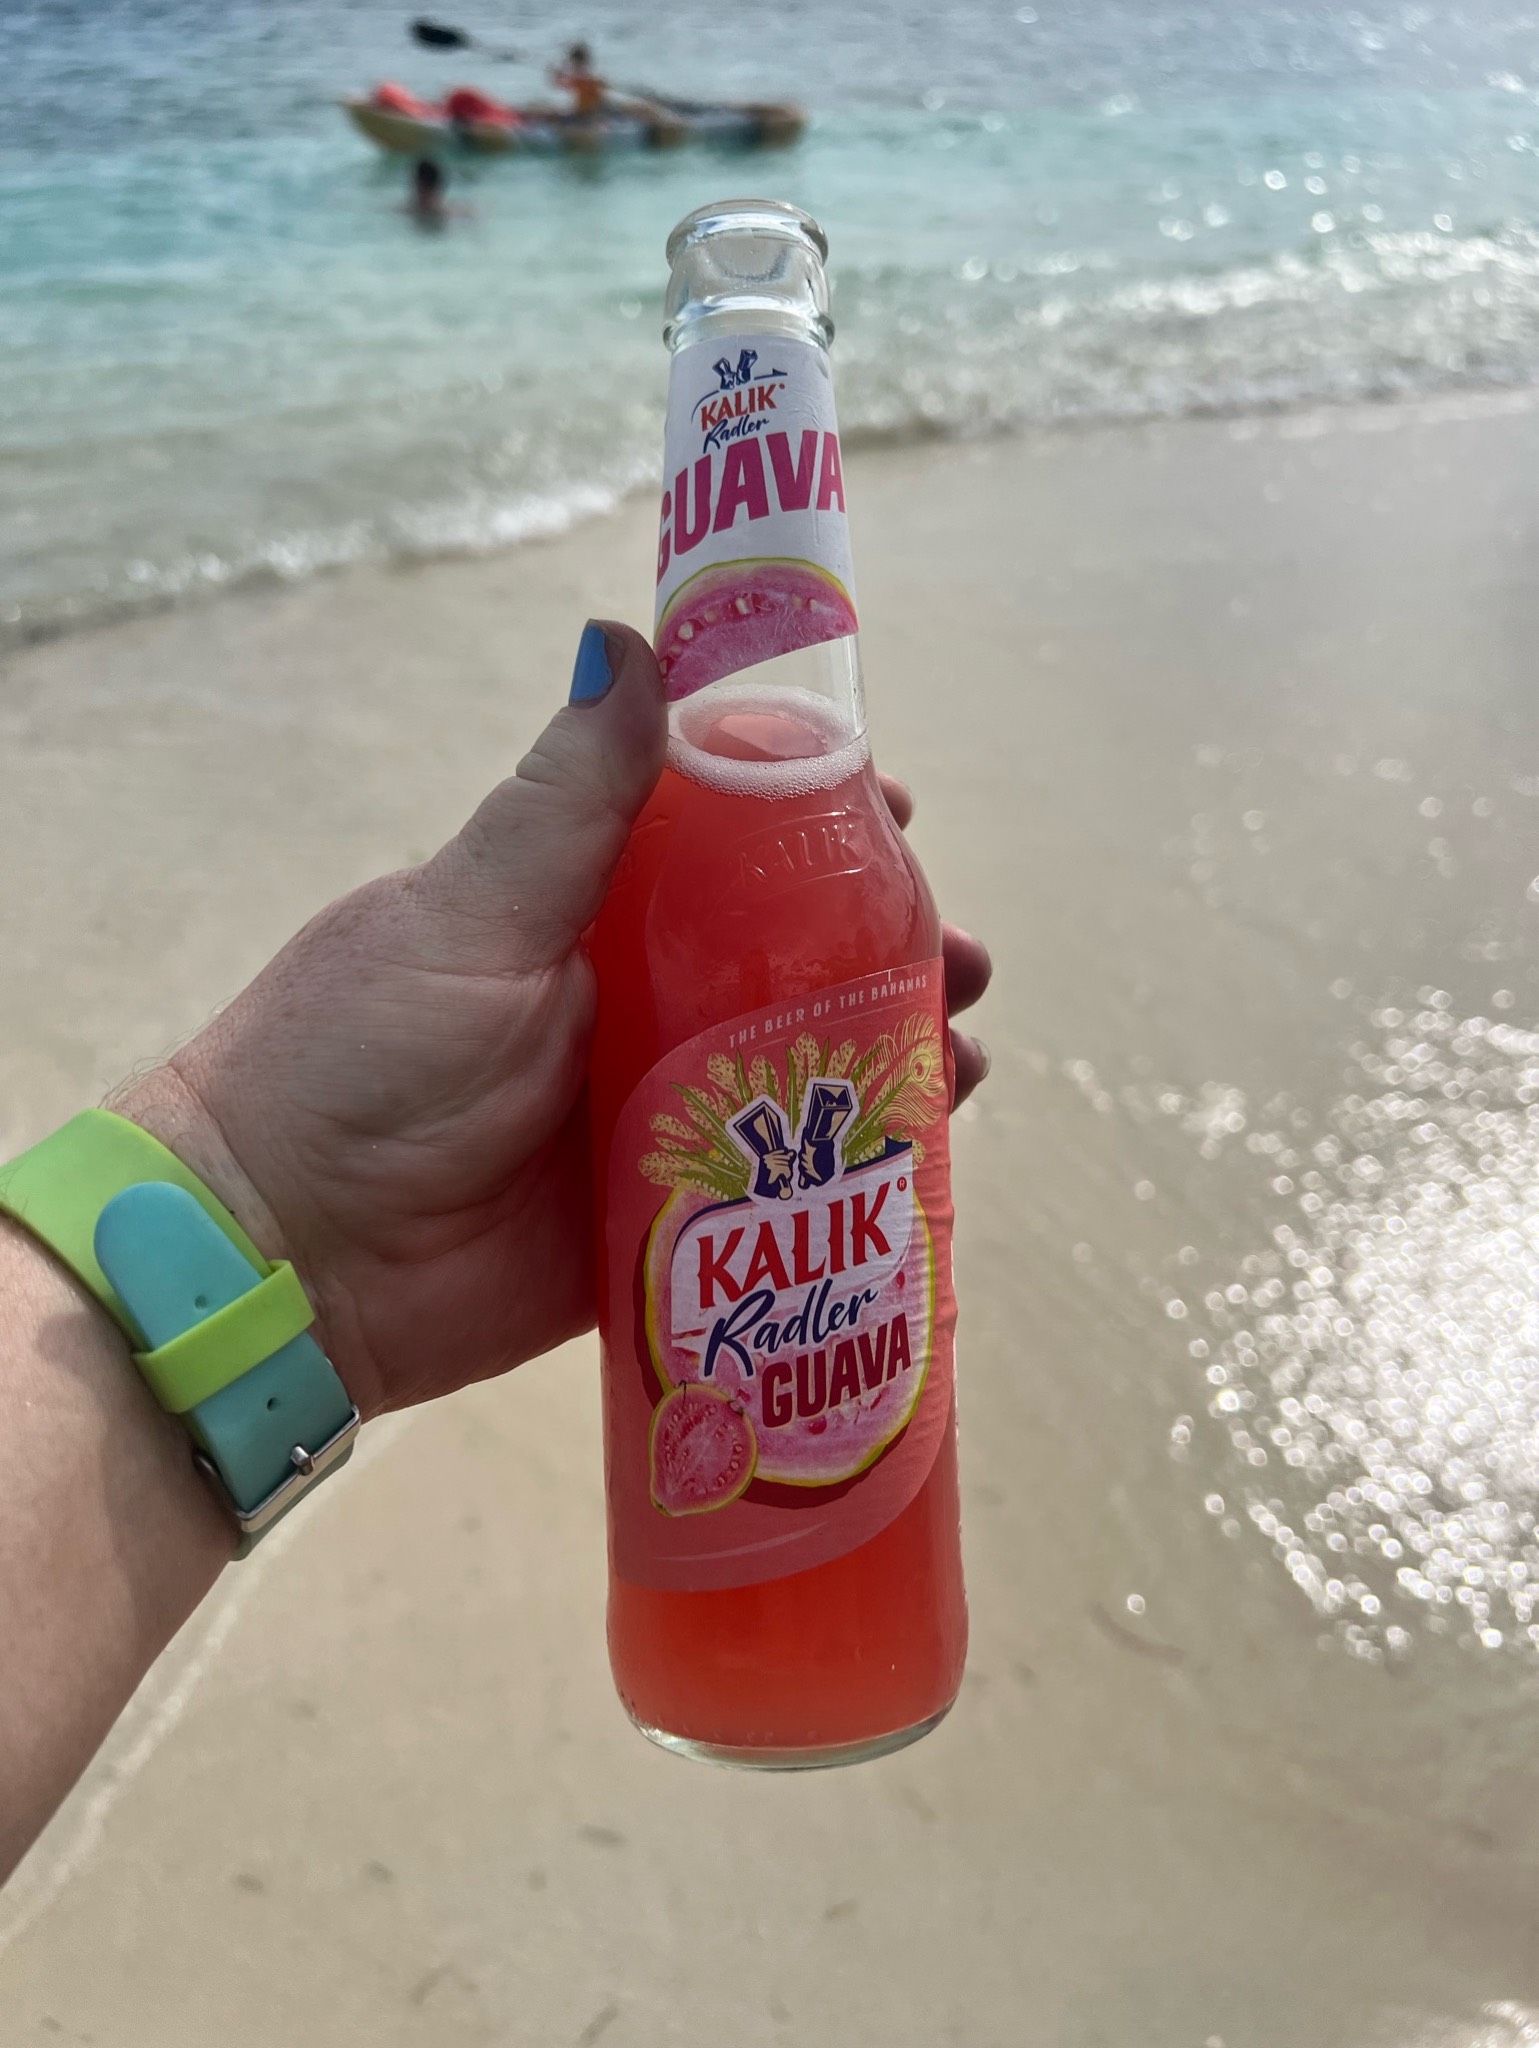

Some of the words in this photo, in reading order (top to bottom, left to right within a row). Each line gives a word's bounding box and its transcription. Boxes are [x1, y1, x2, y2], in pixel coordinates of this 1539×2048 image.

[701, 383, 777, 432] KALIK
[703, 415, 770, 454] Radler
[657, 429, 846, 587] GUAVA
[728, 1025, 757, 1048] THE
[764, 1008, 806, 1034] BEER
[813, 1001, 832, 1018] OF
[840, 990, 865, 1009] THE
[871, 974, 927, 1000] BAHAMAS
[696, 1181, 893, 1309] KALIK
[703, 1278, 878, 1377] Radler
[761, 1312, 912, 1428] GUAVA
